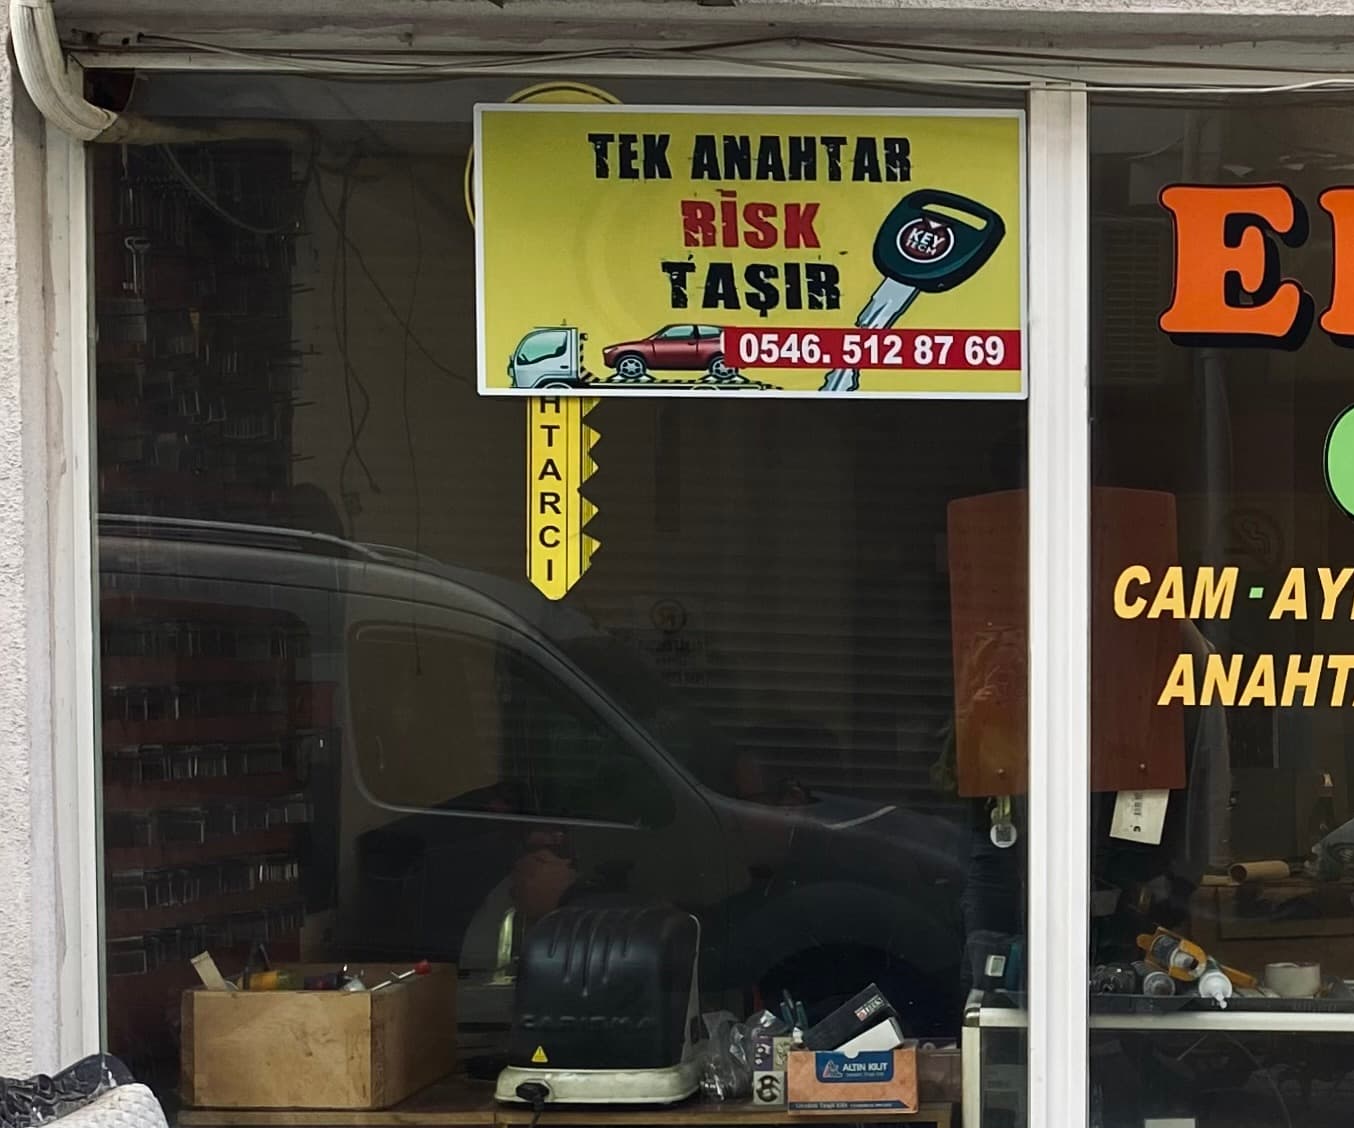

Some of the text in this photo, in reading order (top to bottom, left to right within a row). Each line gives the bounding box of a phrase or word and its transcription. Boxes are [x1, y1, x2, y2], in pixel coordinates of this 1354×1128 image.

[588, 133, 912, 182] TEK ANAHTAR
[681, 189, 820, 248] RİSK
[909, 228, 945, 248] KEY
[661, 261, 840, 317] TAŞIR
[842, 334, 902, 364] 512
[914, 335, 953, 365] 87
[965, 335, 1005, 365] 69
[1114, 566, 1239, 620] CAM
